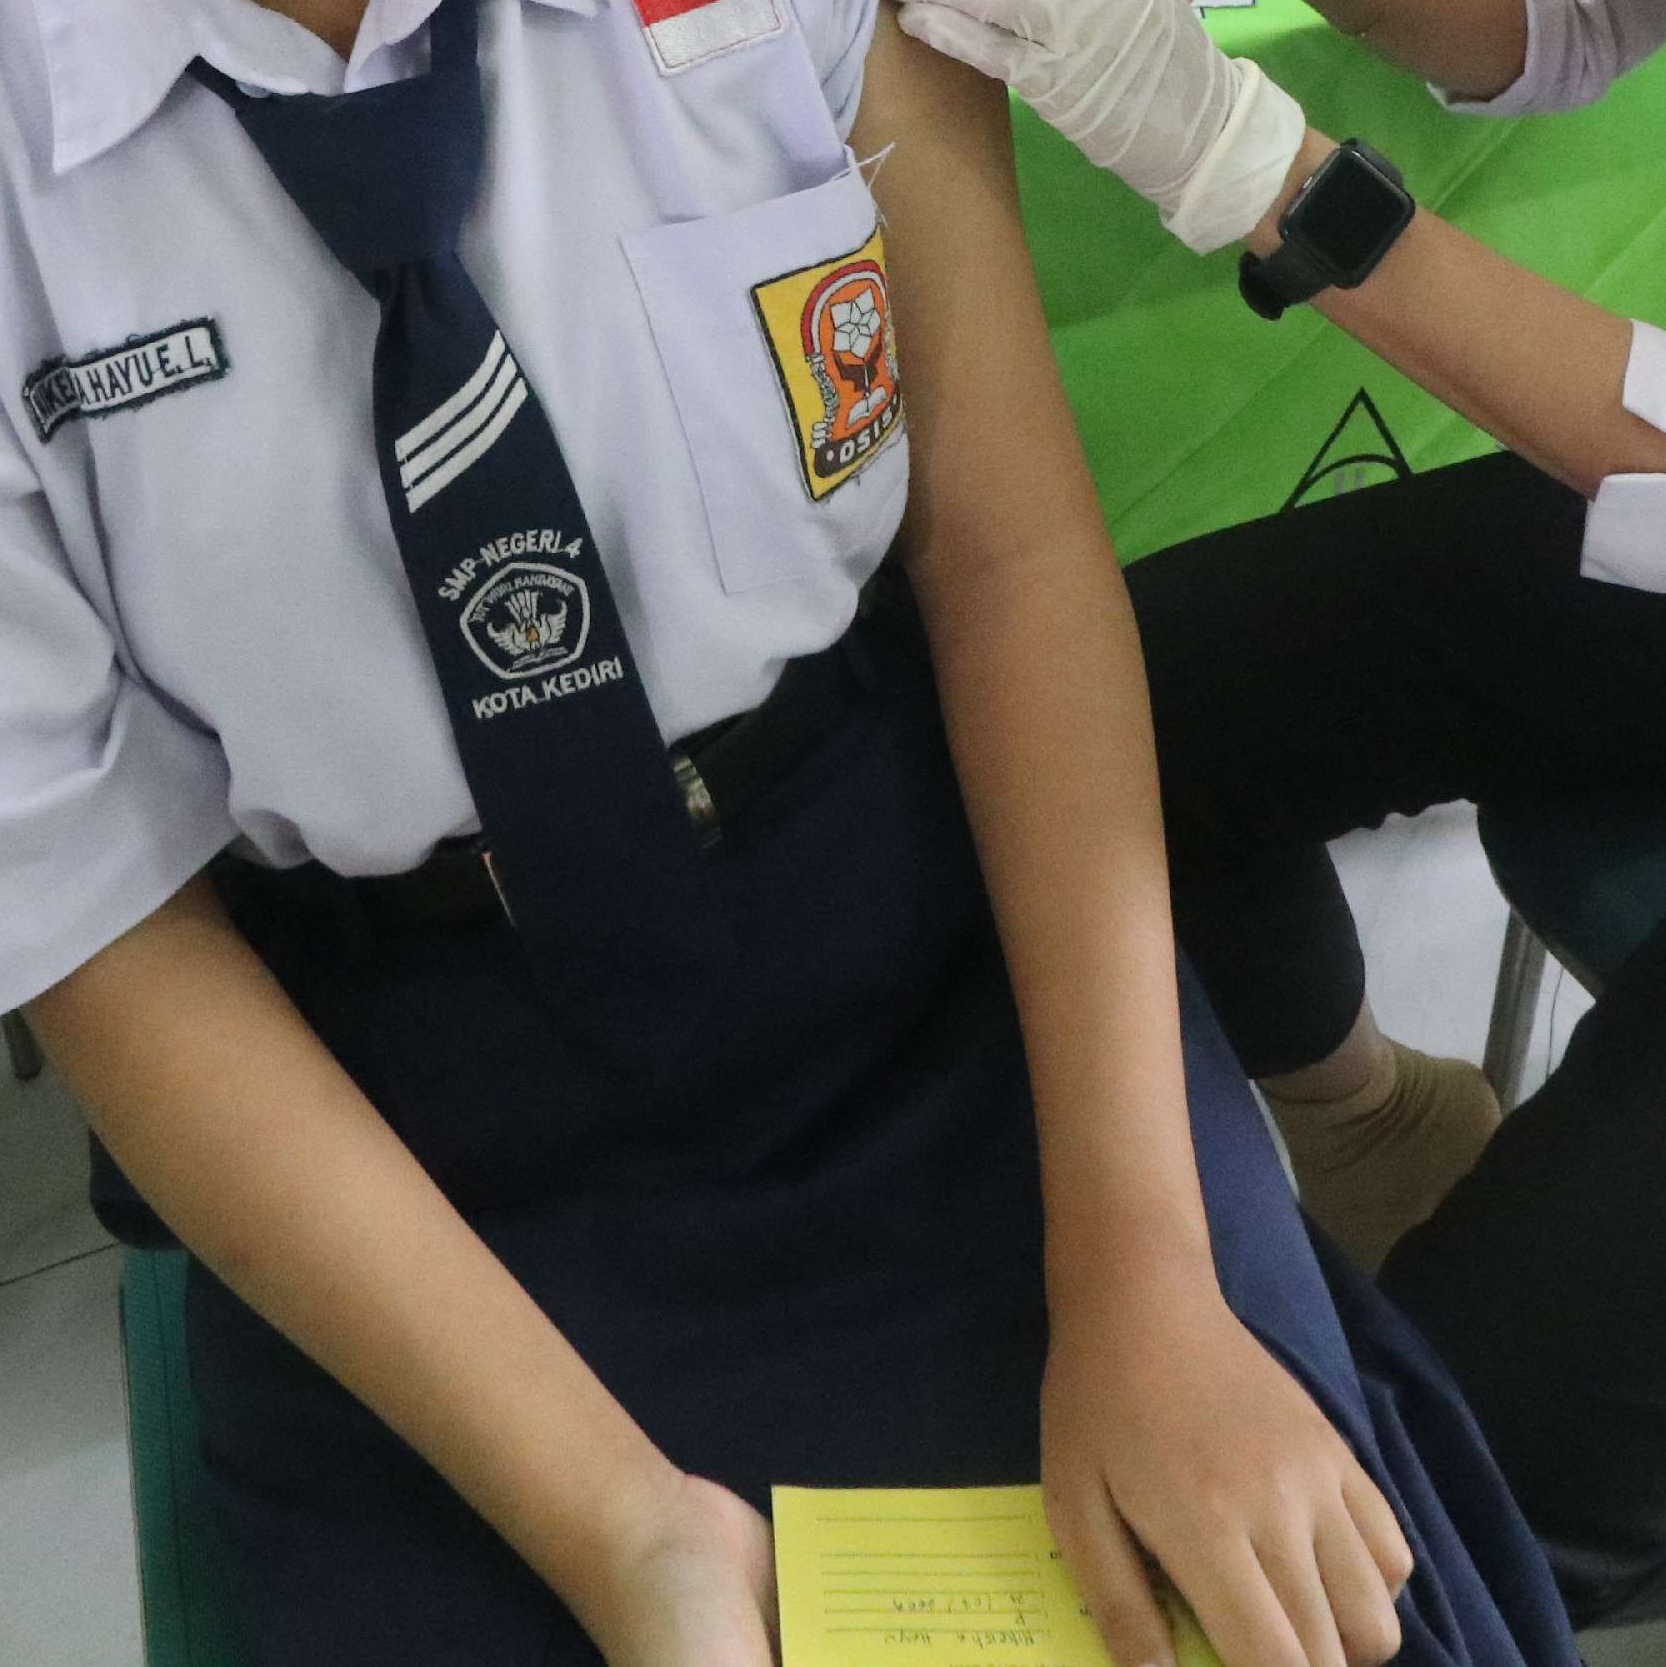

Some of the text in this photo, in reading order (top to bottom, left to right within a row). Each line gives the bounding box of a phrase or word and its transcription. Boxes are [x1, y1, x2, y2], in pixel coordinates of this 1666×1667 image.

[438, 560, 478, 602] SMP
[479, 528, 560, 568] NEGERI
[471, 687, 537, 721] KOTA
[541, 655, 625, 702] KEDIRI
